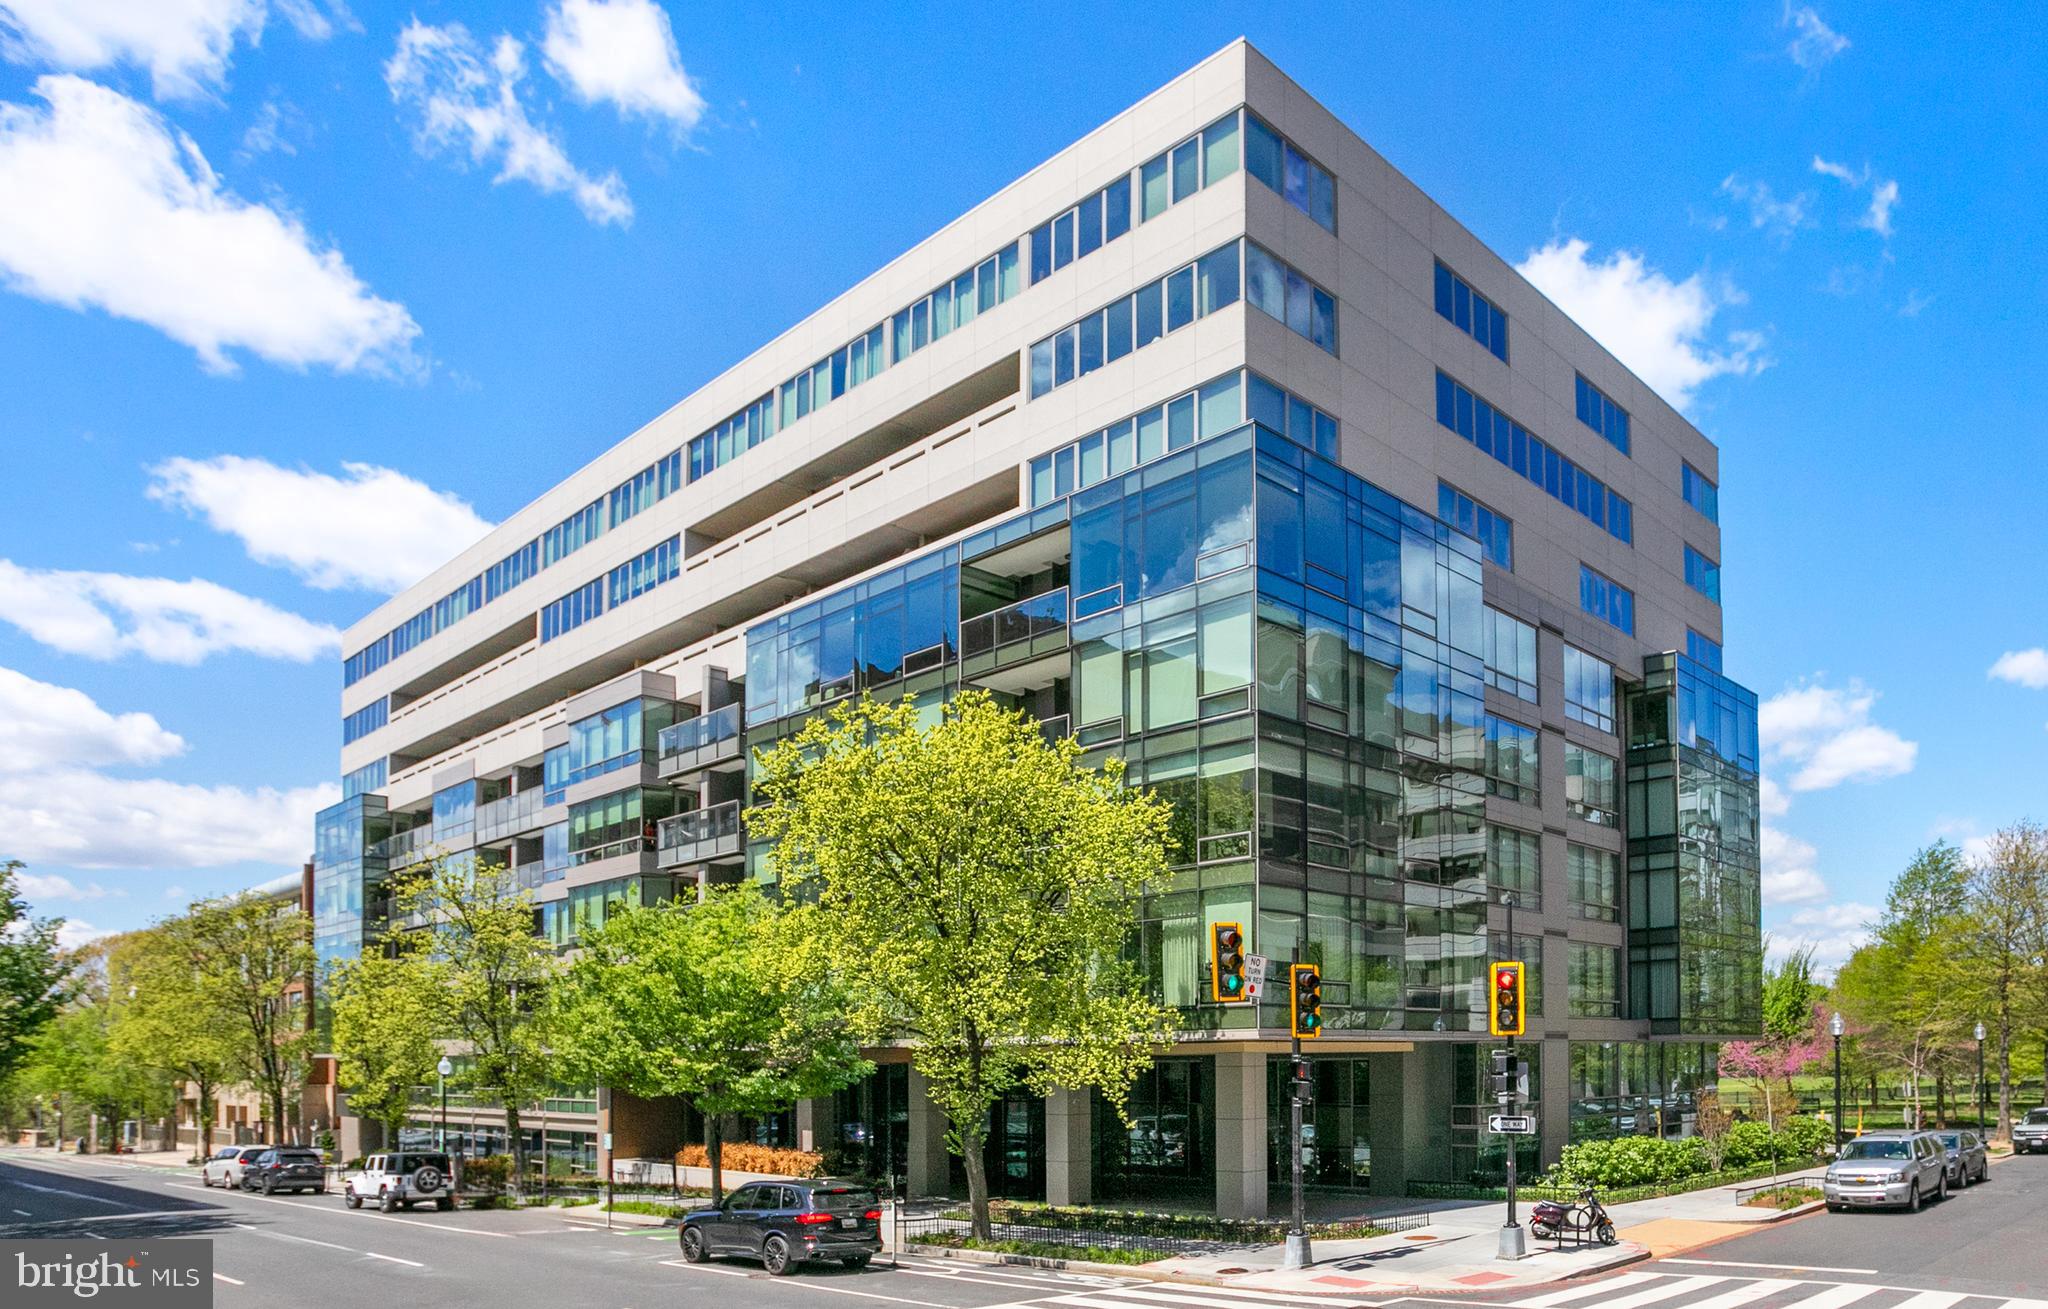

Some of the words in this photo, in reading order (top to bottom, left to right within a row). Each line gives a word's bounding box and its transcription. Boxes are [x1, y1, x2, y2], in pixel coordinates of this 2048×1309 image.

[1250, 957, 1261, 967] NO
[1248, 966, 1261, 975] TURN
[1252, 976, 1263, 985] RED
[1501, 1121, 1511, 1129] ONE
[1512, 1121, 1524, 1129] WAY
